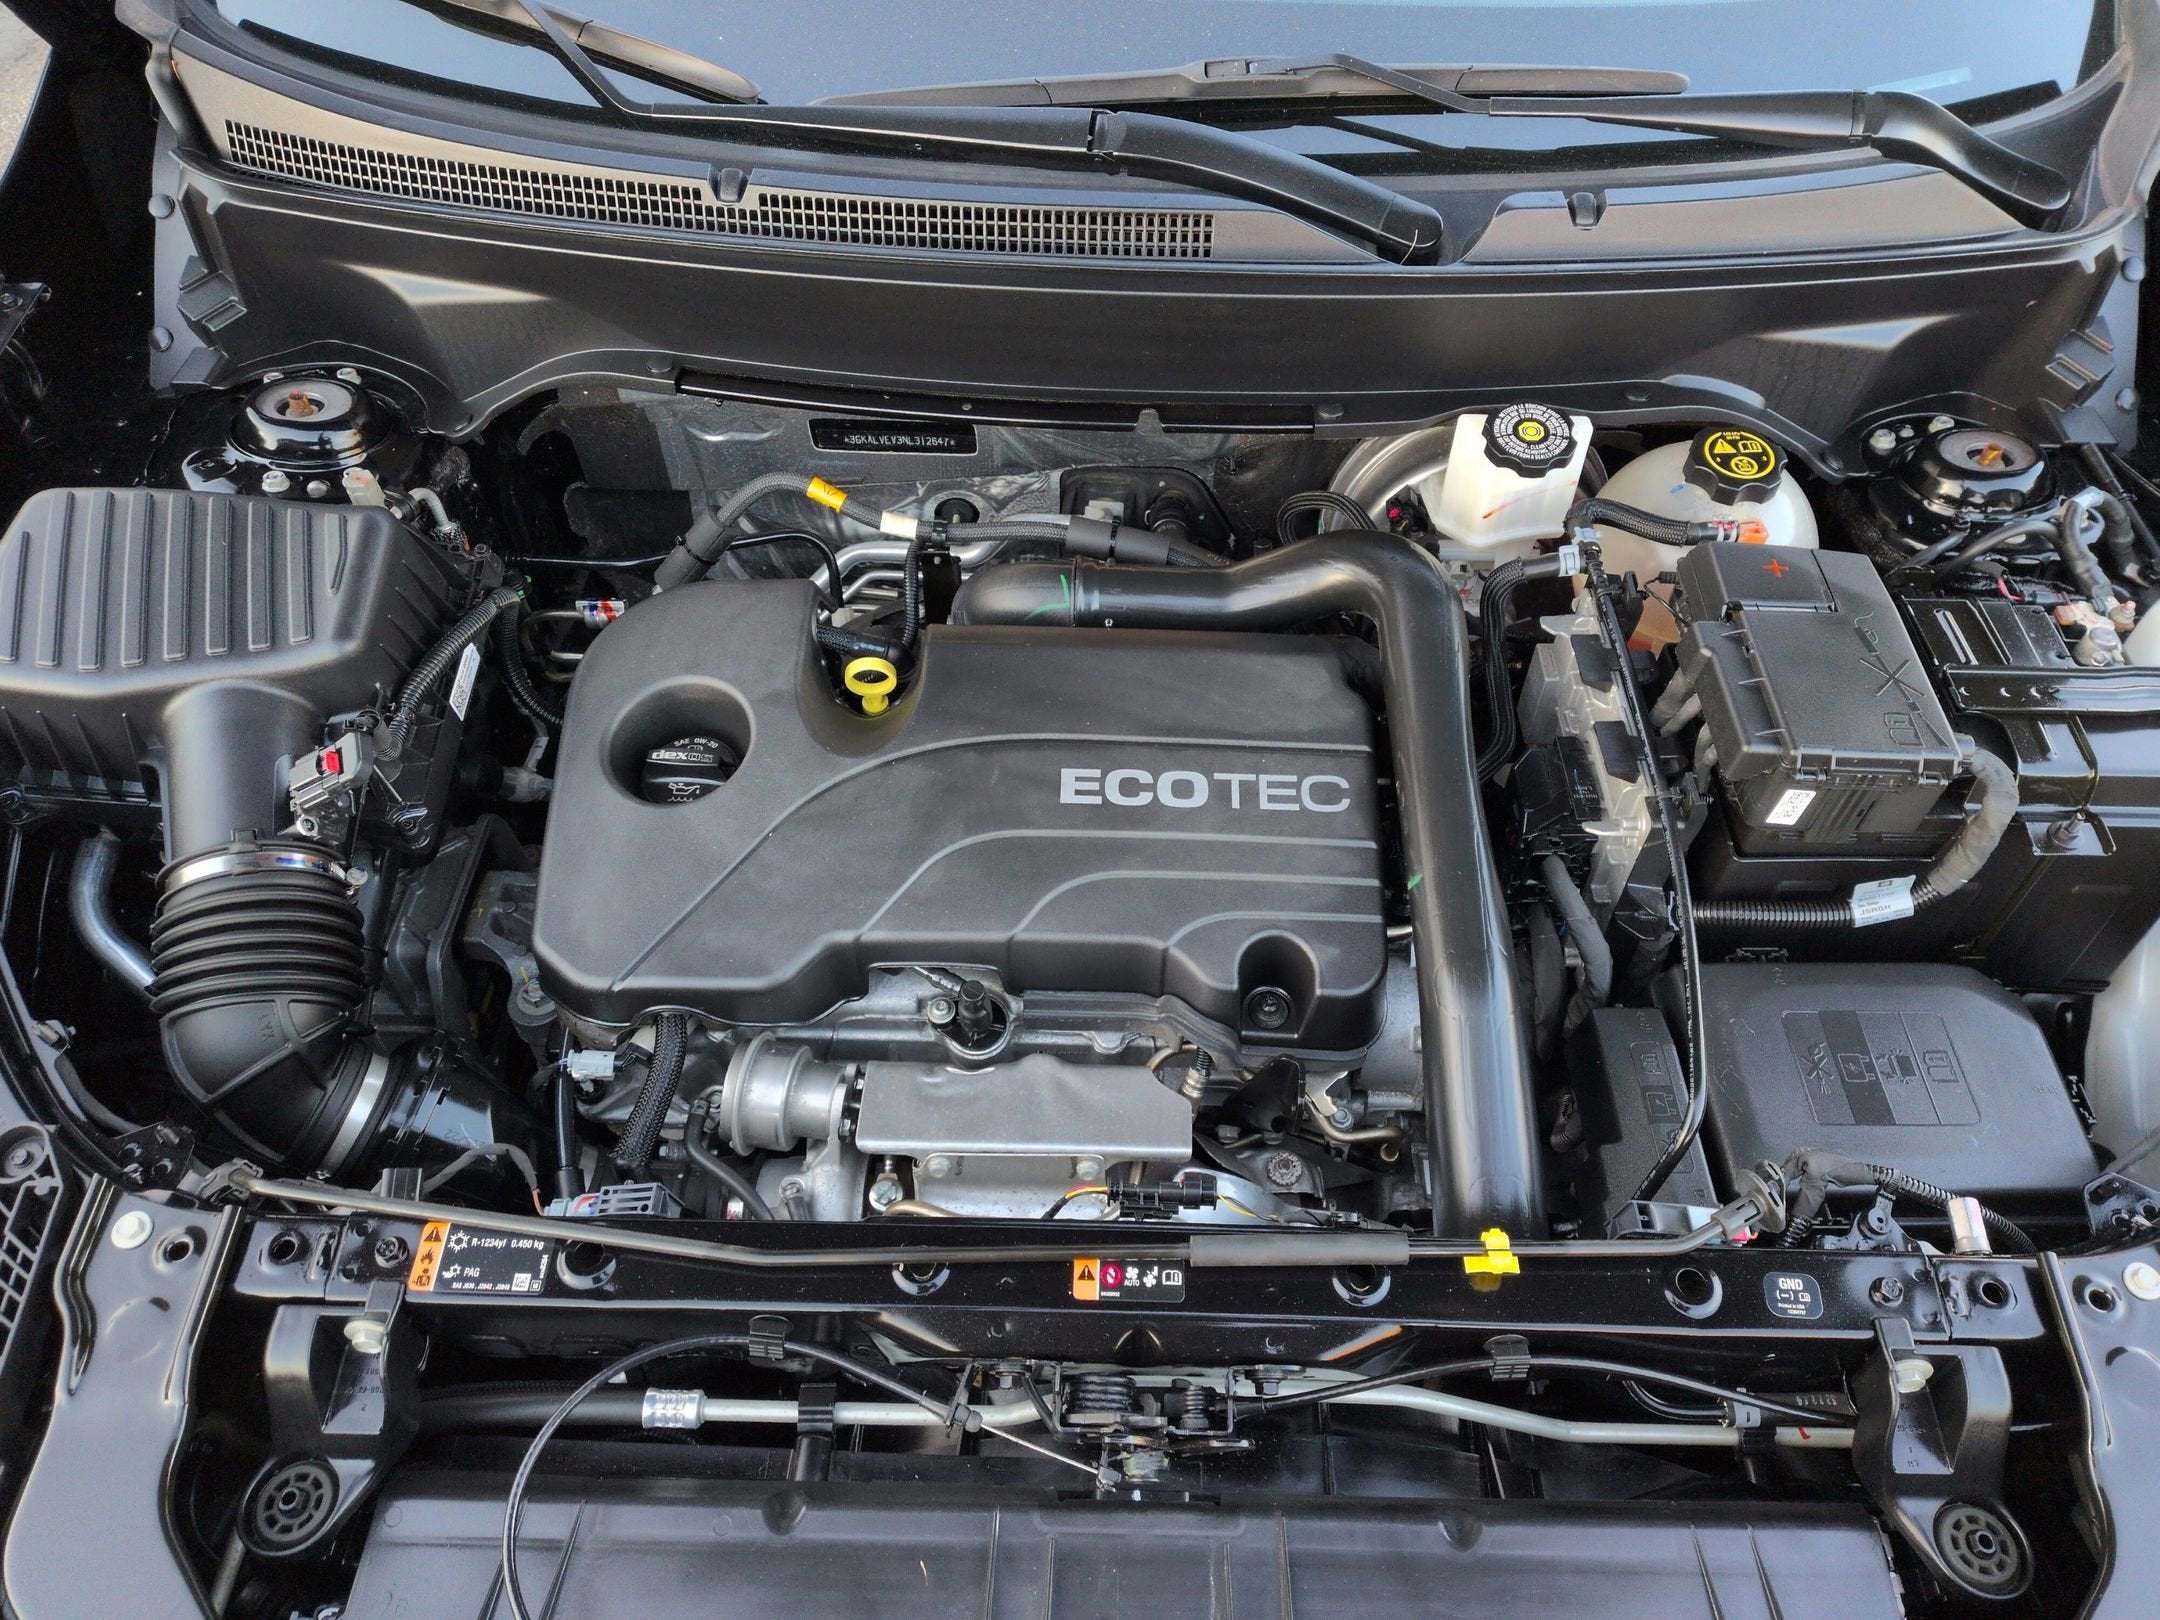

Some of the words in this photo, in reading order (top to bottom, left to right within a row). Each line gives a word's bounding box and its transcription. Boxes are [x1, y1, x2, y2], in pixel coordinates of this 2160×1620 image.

[674, 738, 690, 746] SAE
[694, 737, 718, 748] 0W-20
[652, 749, 713, 762] dexos
[1060, 768, 1350, 812] ECOTEC
[471, 1237, 507, 1249] R-1234yf
[511, 1238, 533, 1249] 0.450
[533, 1239, 545, 1250] kg
[463, 1266, 481, 1278] PAG
[1124, 1279, 1140, 1287] AUTO
[1779, 1277, 1803, 1290] GND
